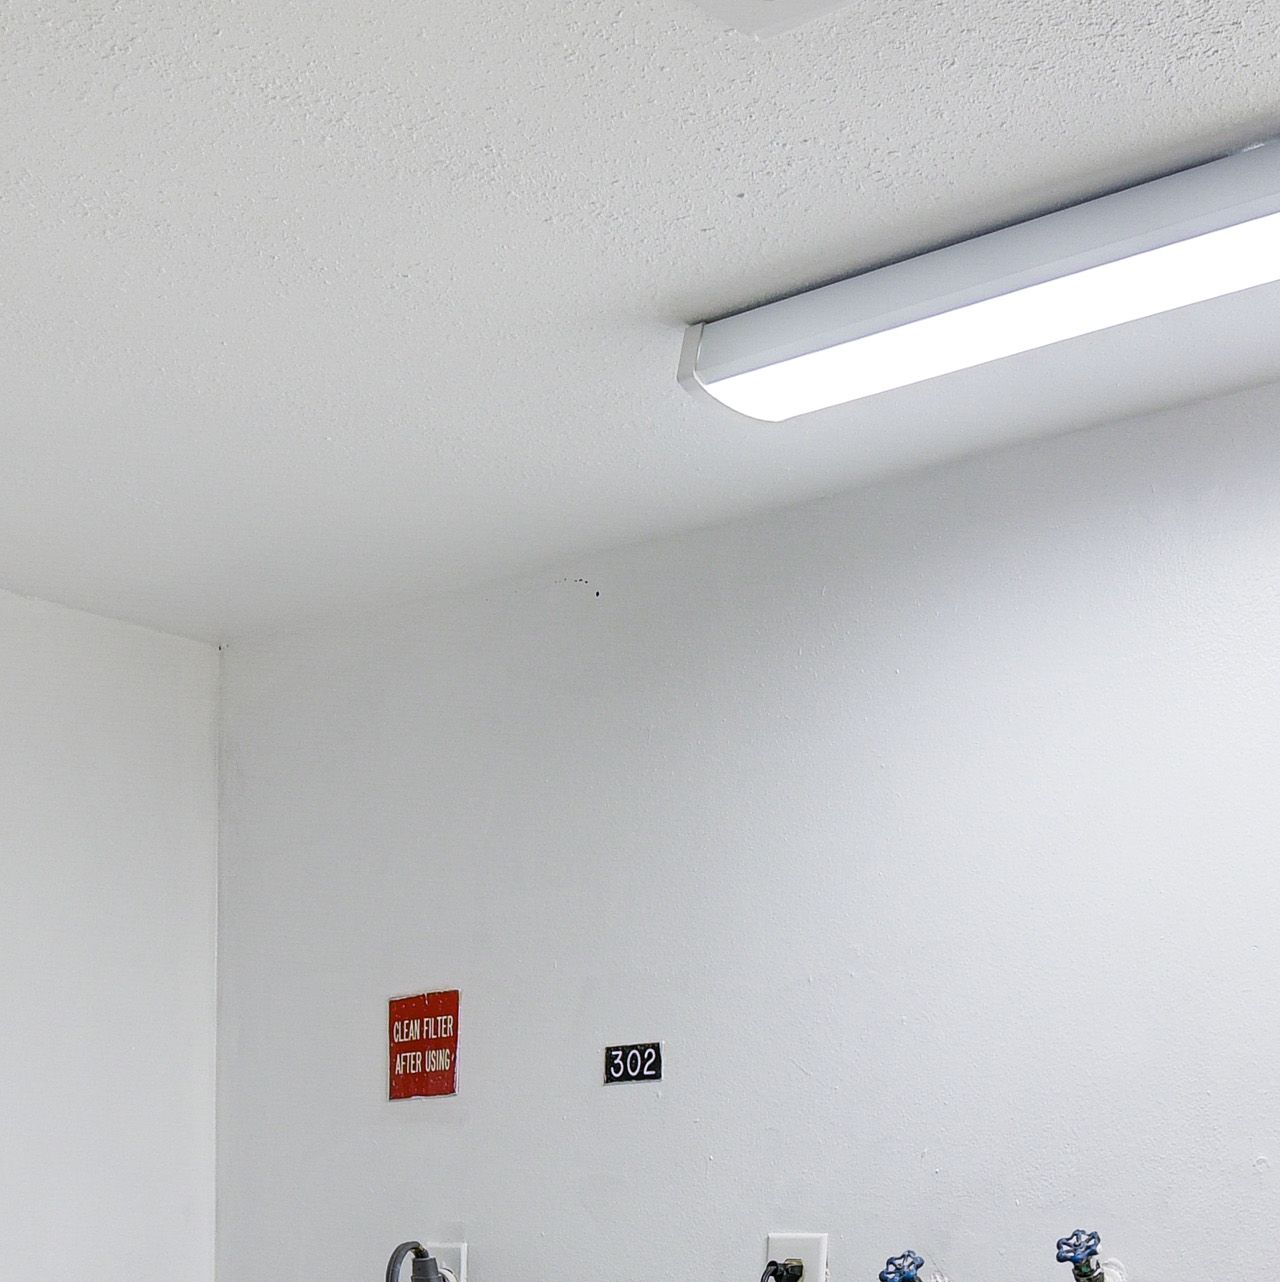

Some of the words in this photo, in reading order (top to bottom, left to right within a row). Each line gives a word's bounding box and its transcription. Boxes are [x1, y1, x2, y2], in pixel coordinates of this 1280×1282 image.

[393, 1019, 420, 1042] CLEAN
[423, 1016, 453, 1038] FILTER
[395, 1051, 422, 1074] AFTER
[425, 1049, 450, 1072] USING
[611, 1049, 656, 1077] 302
